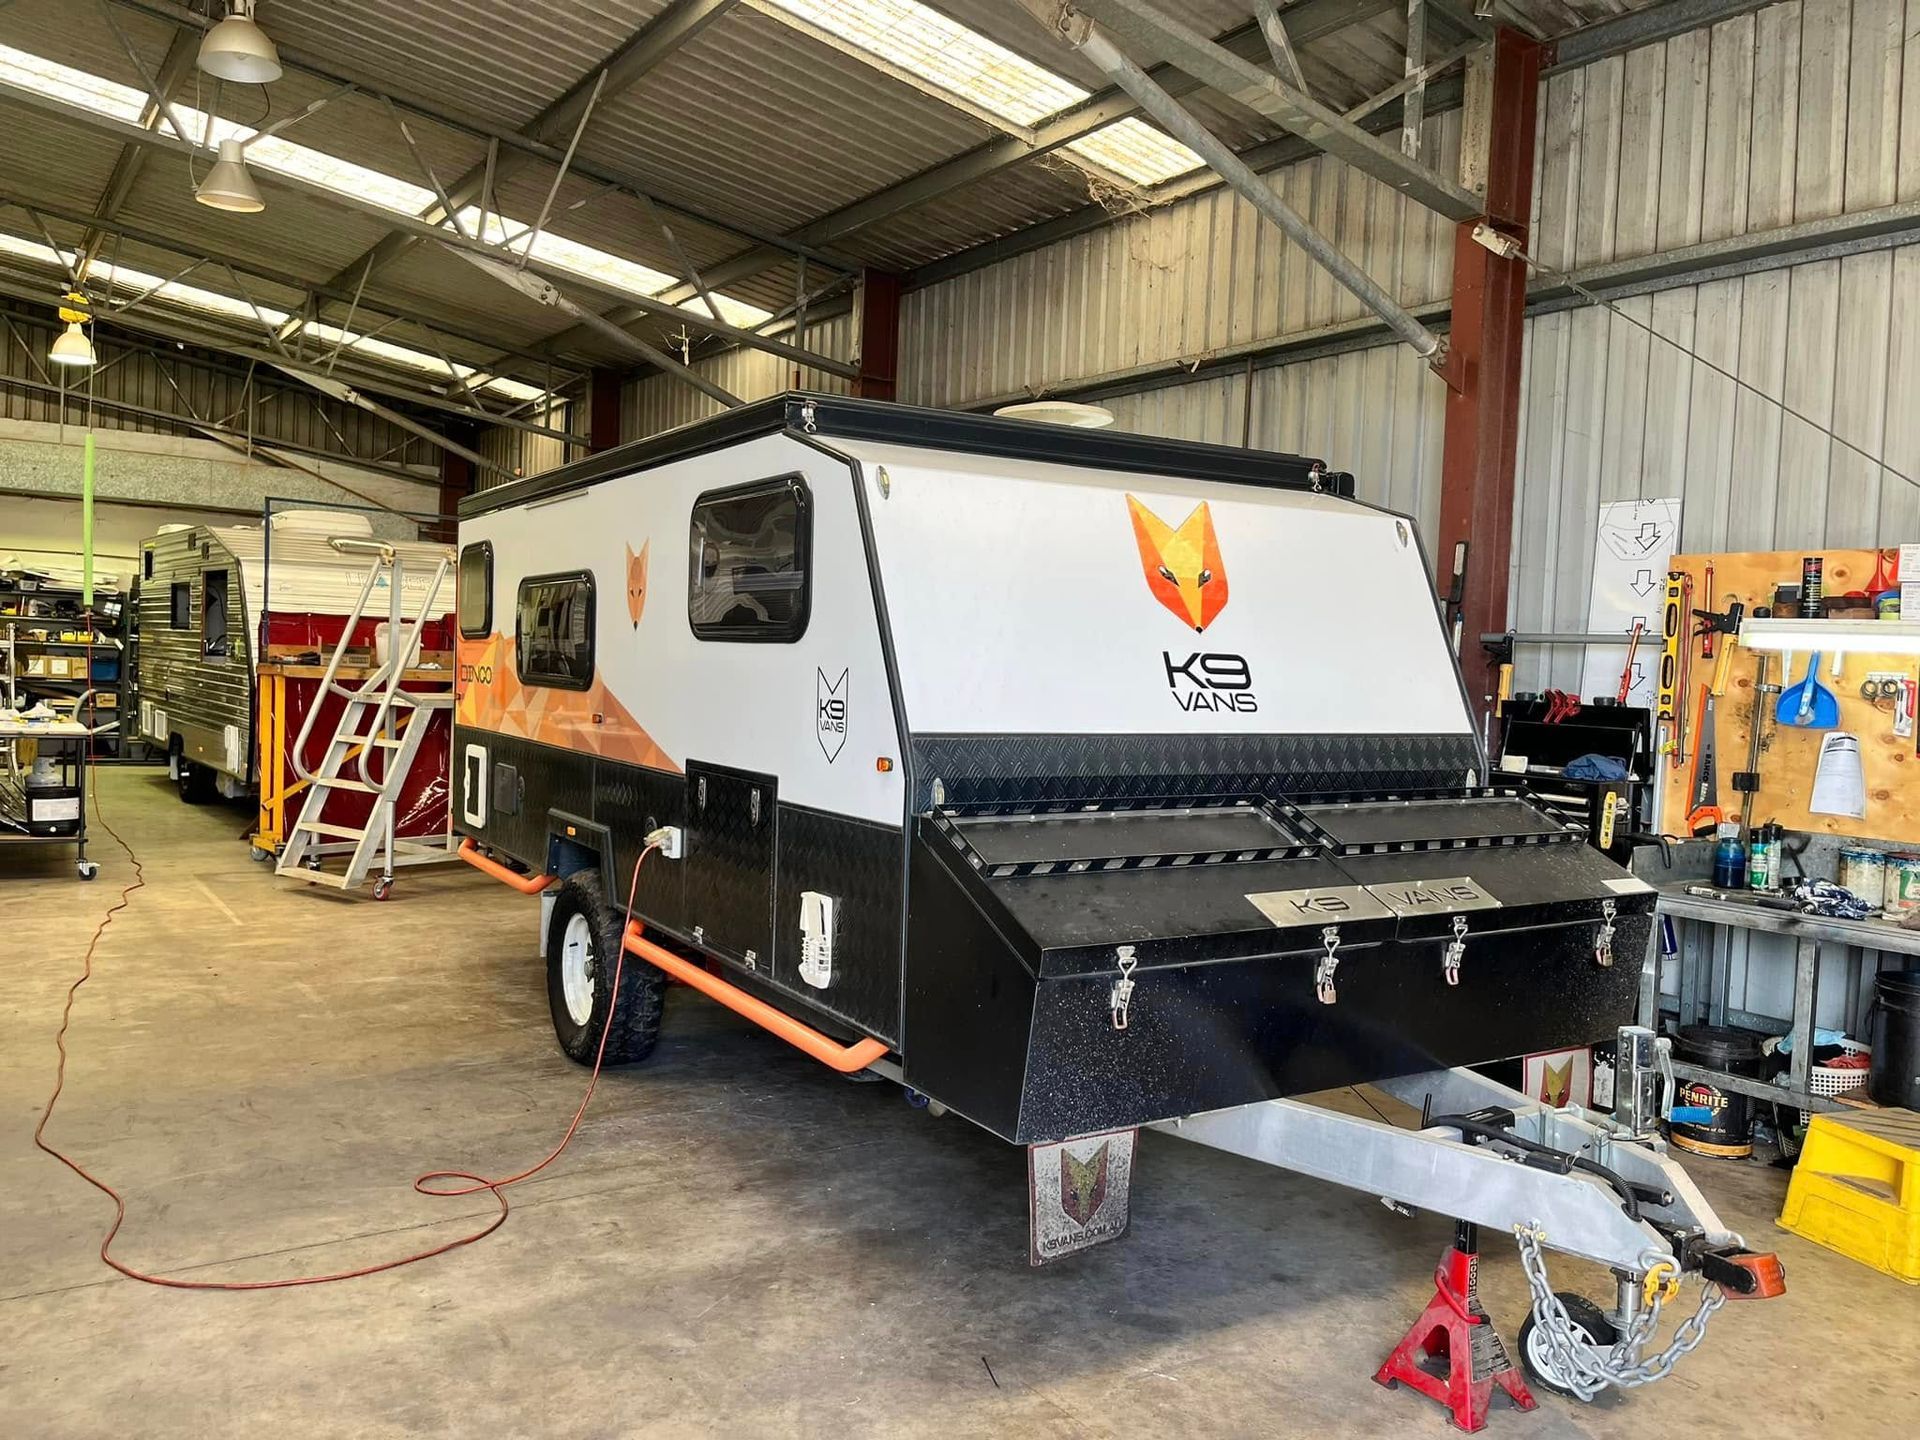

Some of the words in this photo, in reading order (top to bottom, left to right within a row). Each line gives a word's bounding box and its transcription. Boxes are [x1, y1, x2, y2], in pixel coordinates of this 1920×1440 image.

[1162, 651, 1252, 690] K9
[819, 698, 845, 720] K9
[1172, 691, 1258, 712] VANS
[819, 720, 845, 733] VANS
[1290, 896, 1350, 914] K9
[1387, 886, 1480, 906] VANS
[1679, 1086, 1729, 1108] PENRITE
